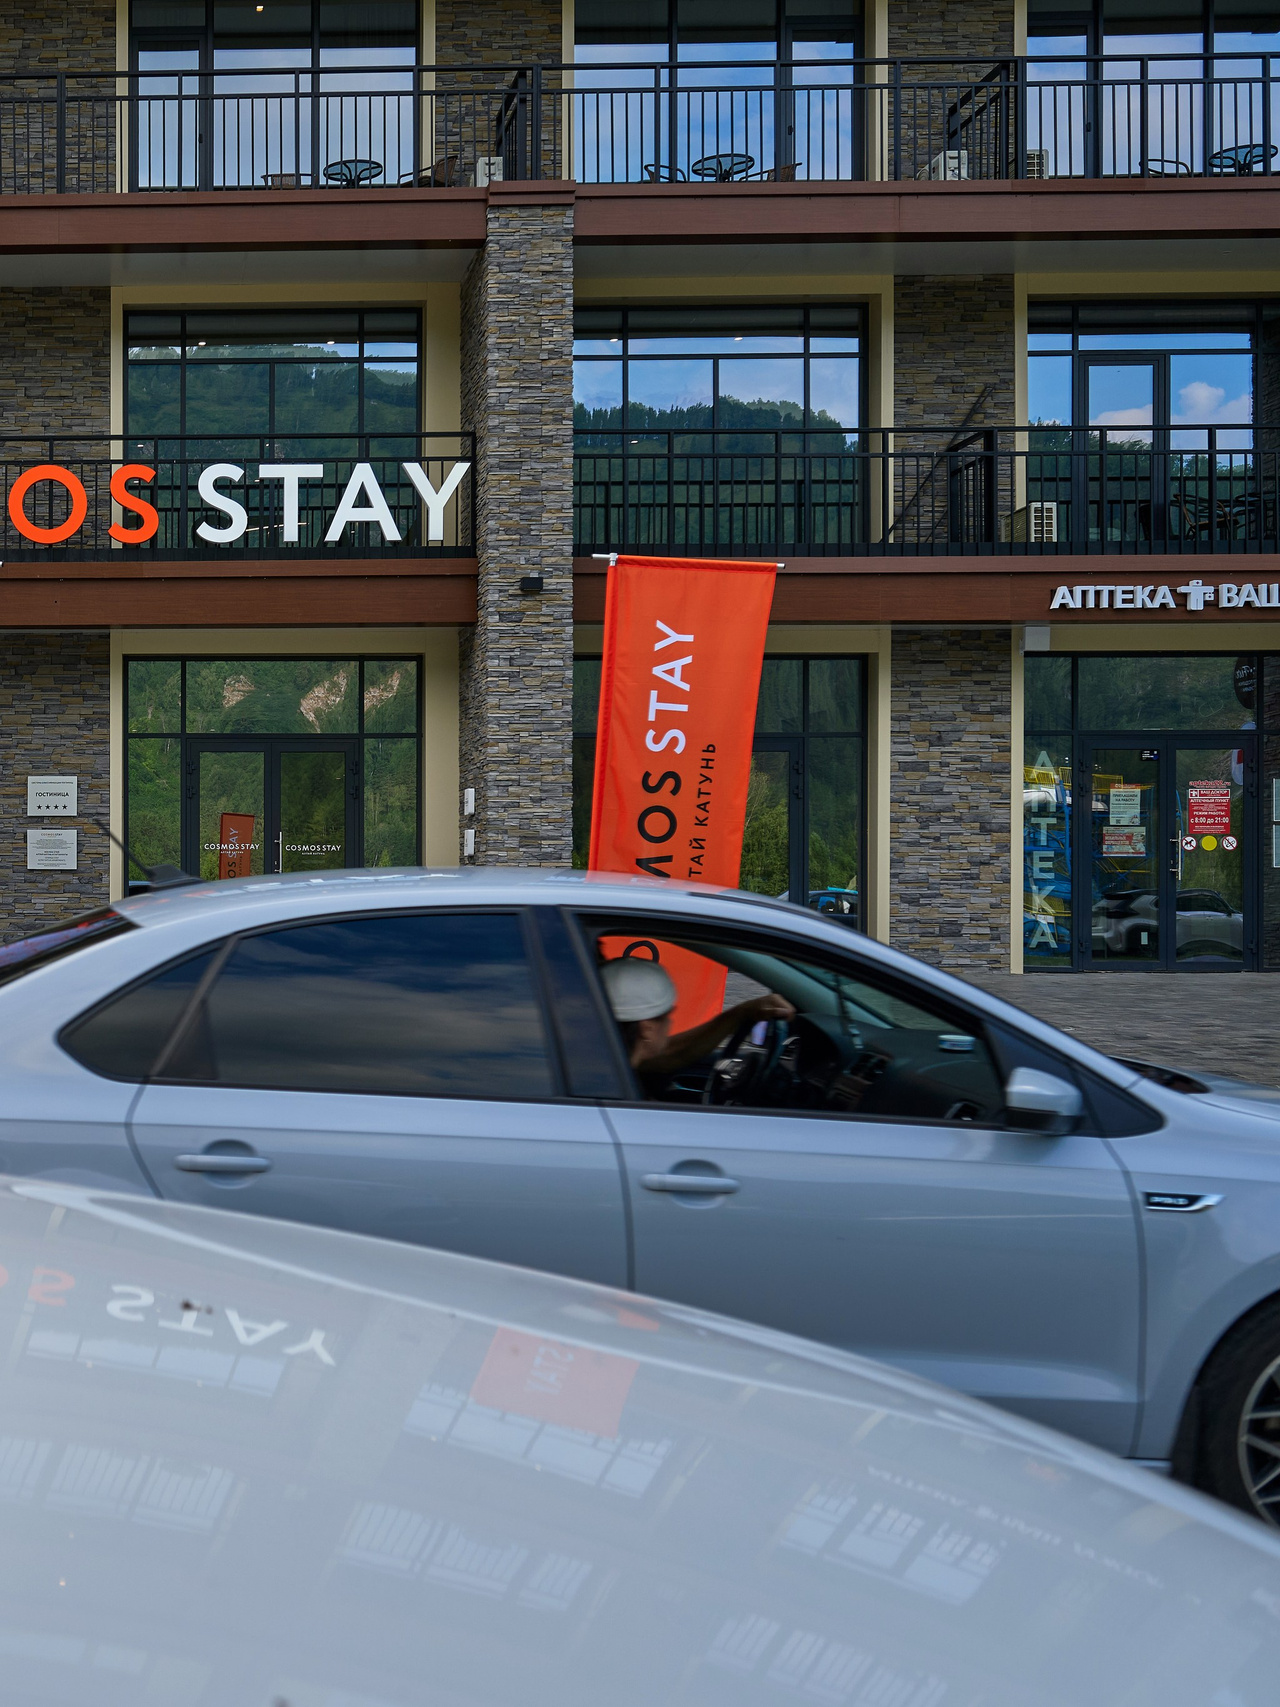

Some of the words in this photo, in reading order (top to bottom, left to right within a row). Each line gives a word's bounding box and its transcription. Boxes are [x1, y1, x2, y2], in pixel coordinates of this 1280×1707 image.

[196, 462, 471, 544] STAY
[1050, 585, 1176, 610] АПТЕКА
[645, 619, 695, 755] STAY
[694, 743, 716, 827] КАТУНЬ
[285, 844, 320, 852] COSMOS
[688, 838, 707, 878] ТАЙ
[1029, 750, 1058, 949] АПТЕКА
